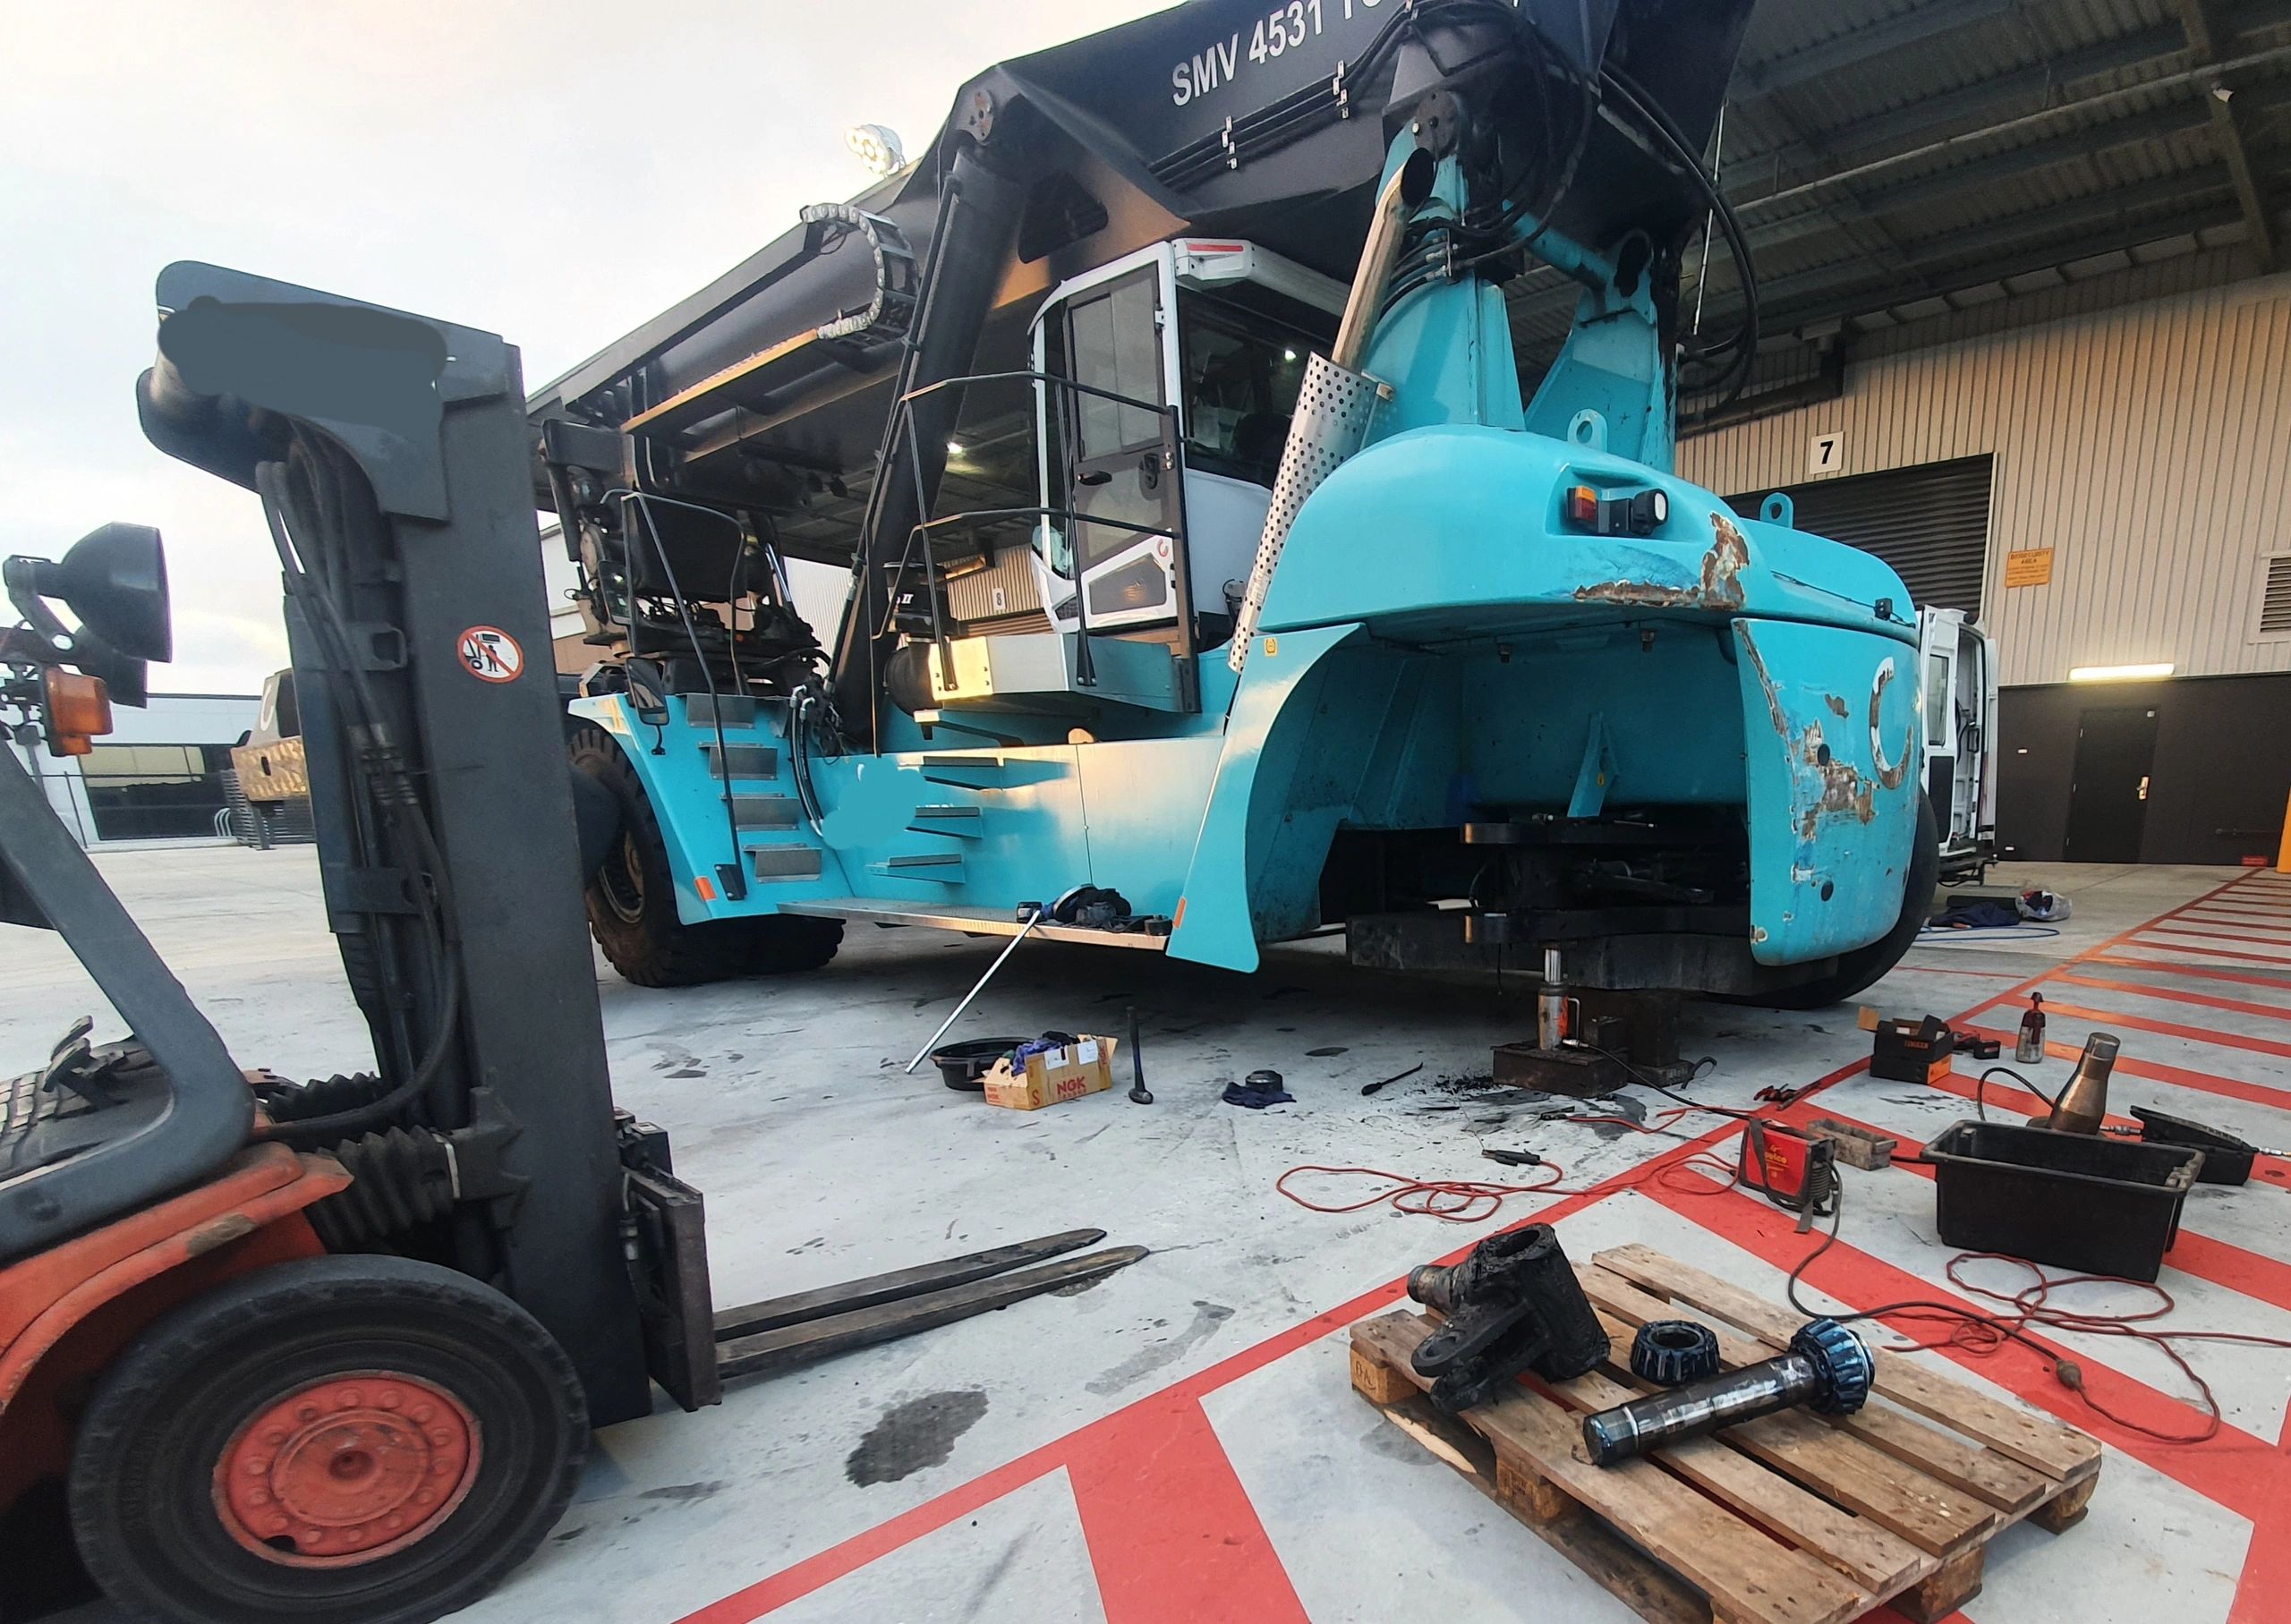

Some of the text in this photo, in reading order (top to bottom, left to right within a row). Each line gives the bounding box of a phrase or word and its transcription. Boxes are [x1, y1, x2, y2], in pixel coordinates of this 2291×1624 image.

[1171, 0, 1324, 106] SMV 4531
[1819, 439, 1834, 464] 7
[1057, 1076, 1086, 1095] NGK
